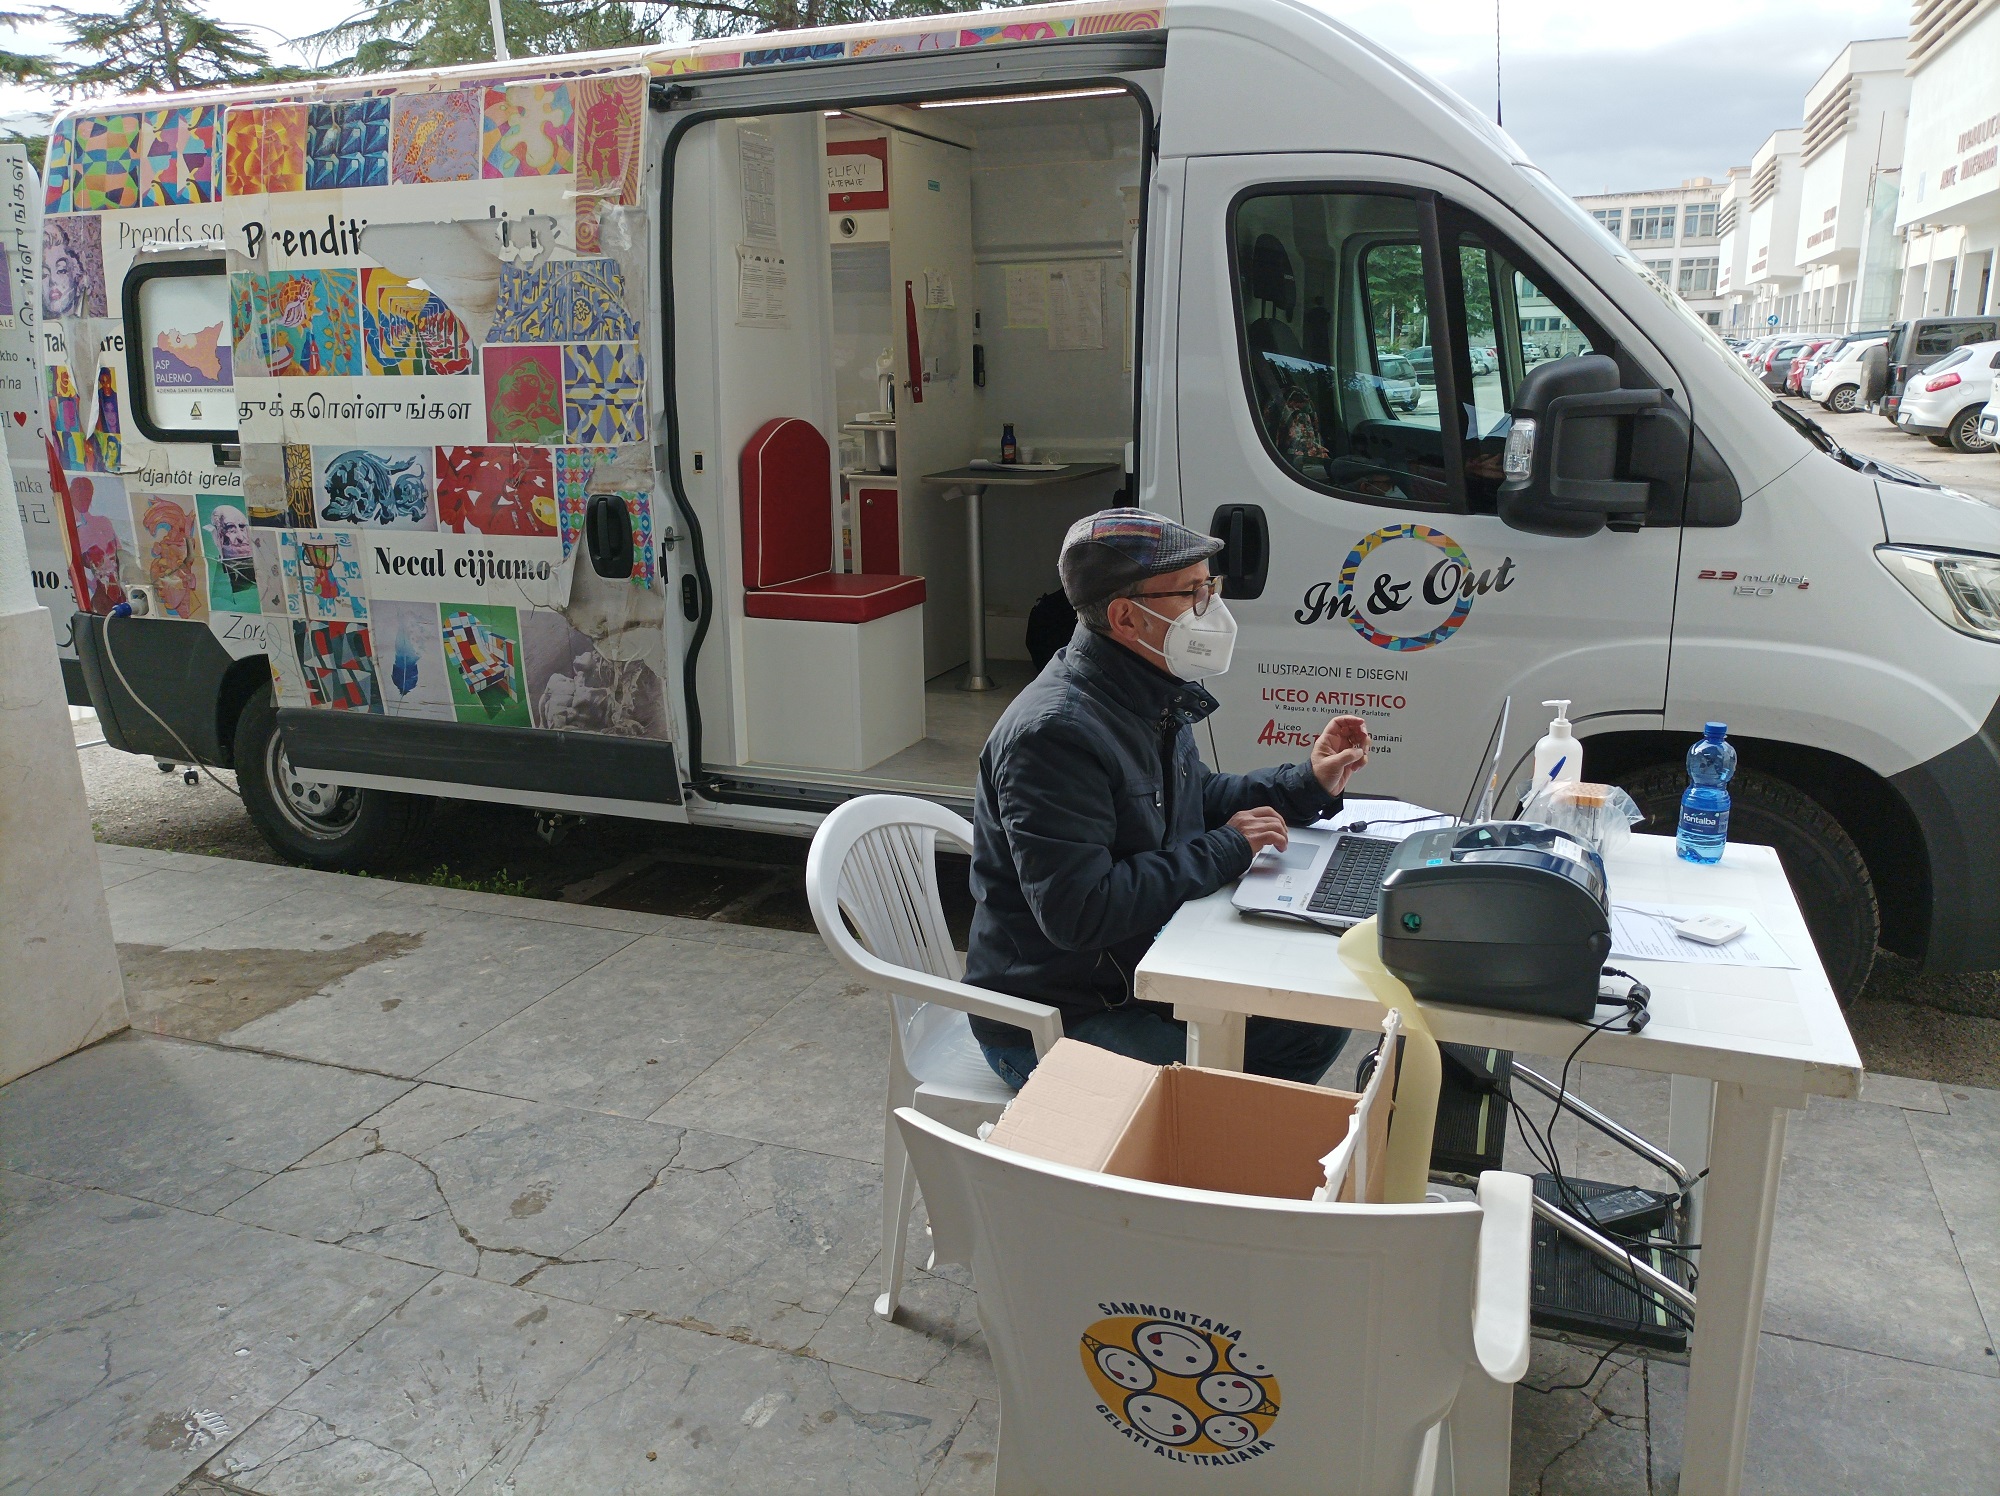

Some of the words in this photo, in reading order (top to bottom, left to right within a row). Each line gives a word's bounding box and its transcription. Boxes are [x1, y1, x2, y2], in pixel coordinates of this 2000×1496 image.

[155, 359, 170, 370] ASP
[156, 372, 193, 383] PALERMO
[373, 546, 447, 578] Necal
[453, 549, 551, 587] cijiamo
[1294, 581, 1356, 626] In
[1366, 573, 1413, 616] &
[1422, 556, 1516, 606] Out
[1345, 668, 1352, 679] E
[1356, 668, 1408, 682] DISEGNI
[1262, 687, 1310, 703] LICEO
[1314, 691, 1407, 710] ARTISTICO
[1361, 710, 1391, 718] Parlatore
[1278, 722, 1302, 732] Liceo
[1683, 812, 1717, 826] Fontalba
[1097, 1301, 1243, 1342] SAMMONTANA
[1095, 1403, 1150, 1449] GELATI
[1153, 1438, 1276, 1467] ALL'ITALIANA
